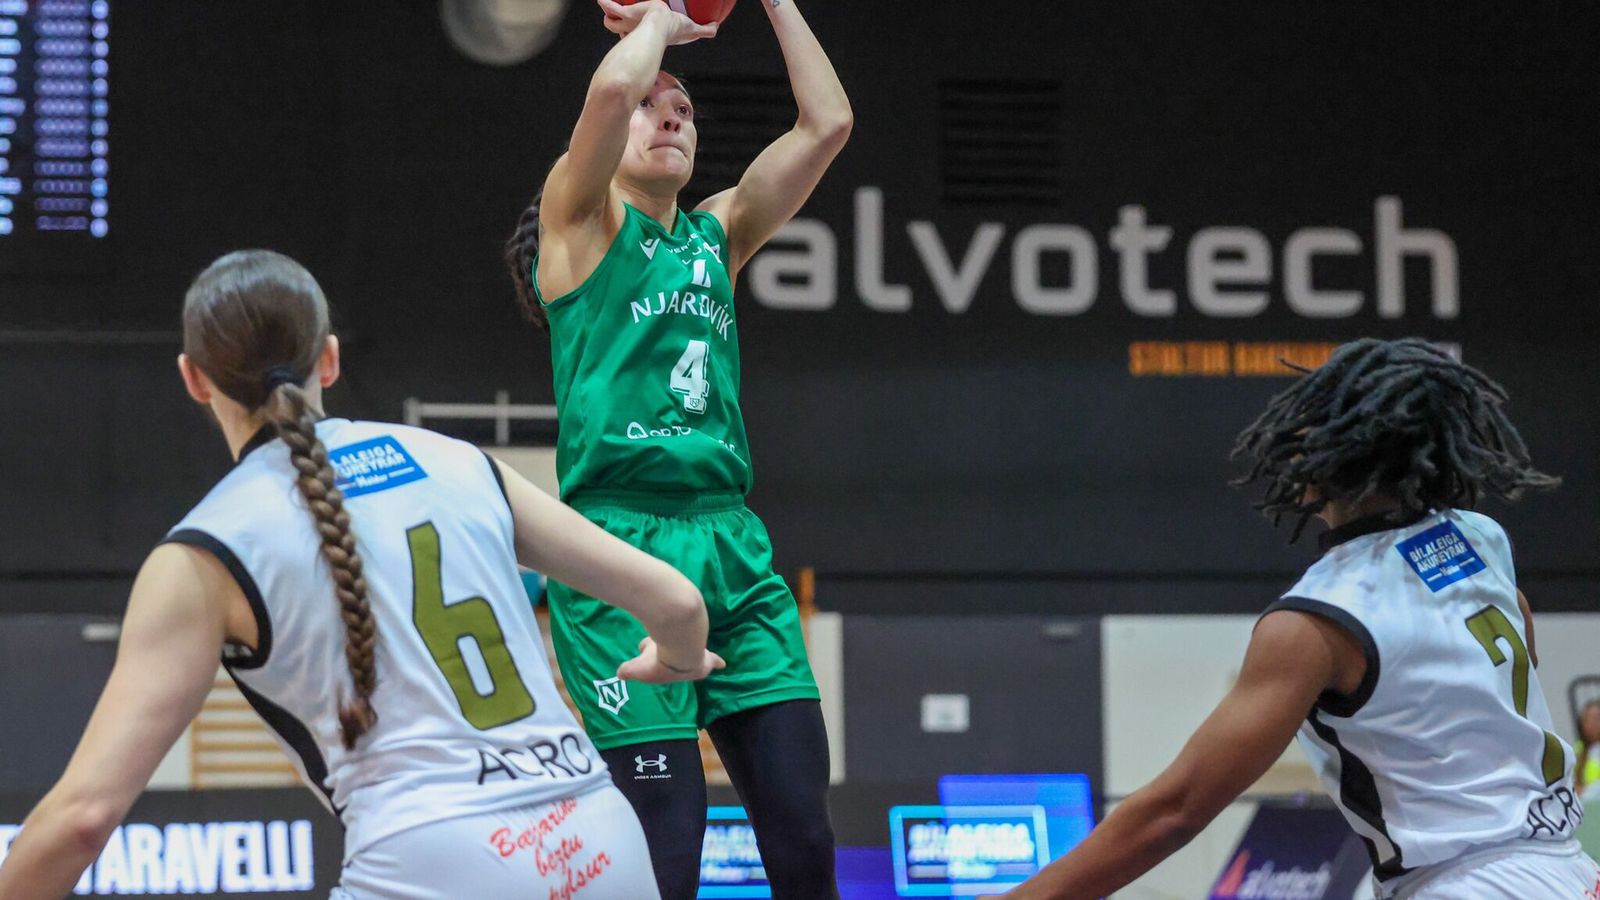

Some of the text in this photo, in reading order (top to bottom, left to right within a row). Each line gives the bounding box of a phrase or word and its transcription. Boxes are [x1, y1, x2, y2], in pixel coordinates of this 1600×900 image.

[748, 186, 1460, 319] alvotech
[630, 290, 734, 341] NJARÐVÍK
[670, 339, 709, 414] 4
[405, 520, 536, 731] 6
[478, 733, 591, 785] ACRO
[1527, 786, 1584, 839] ACR
